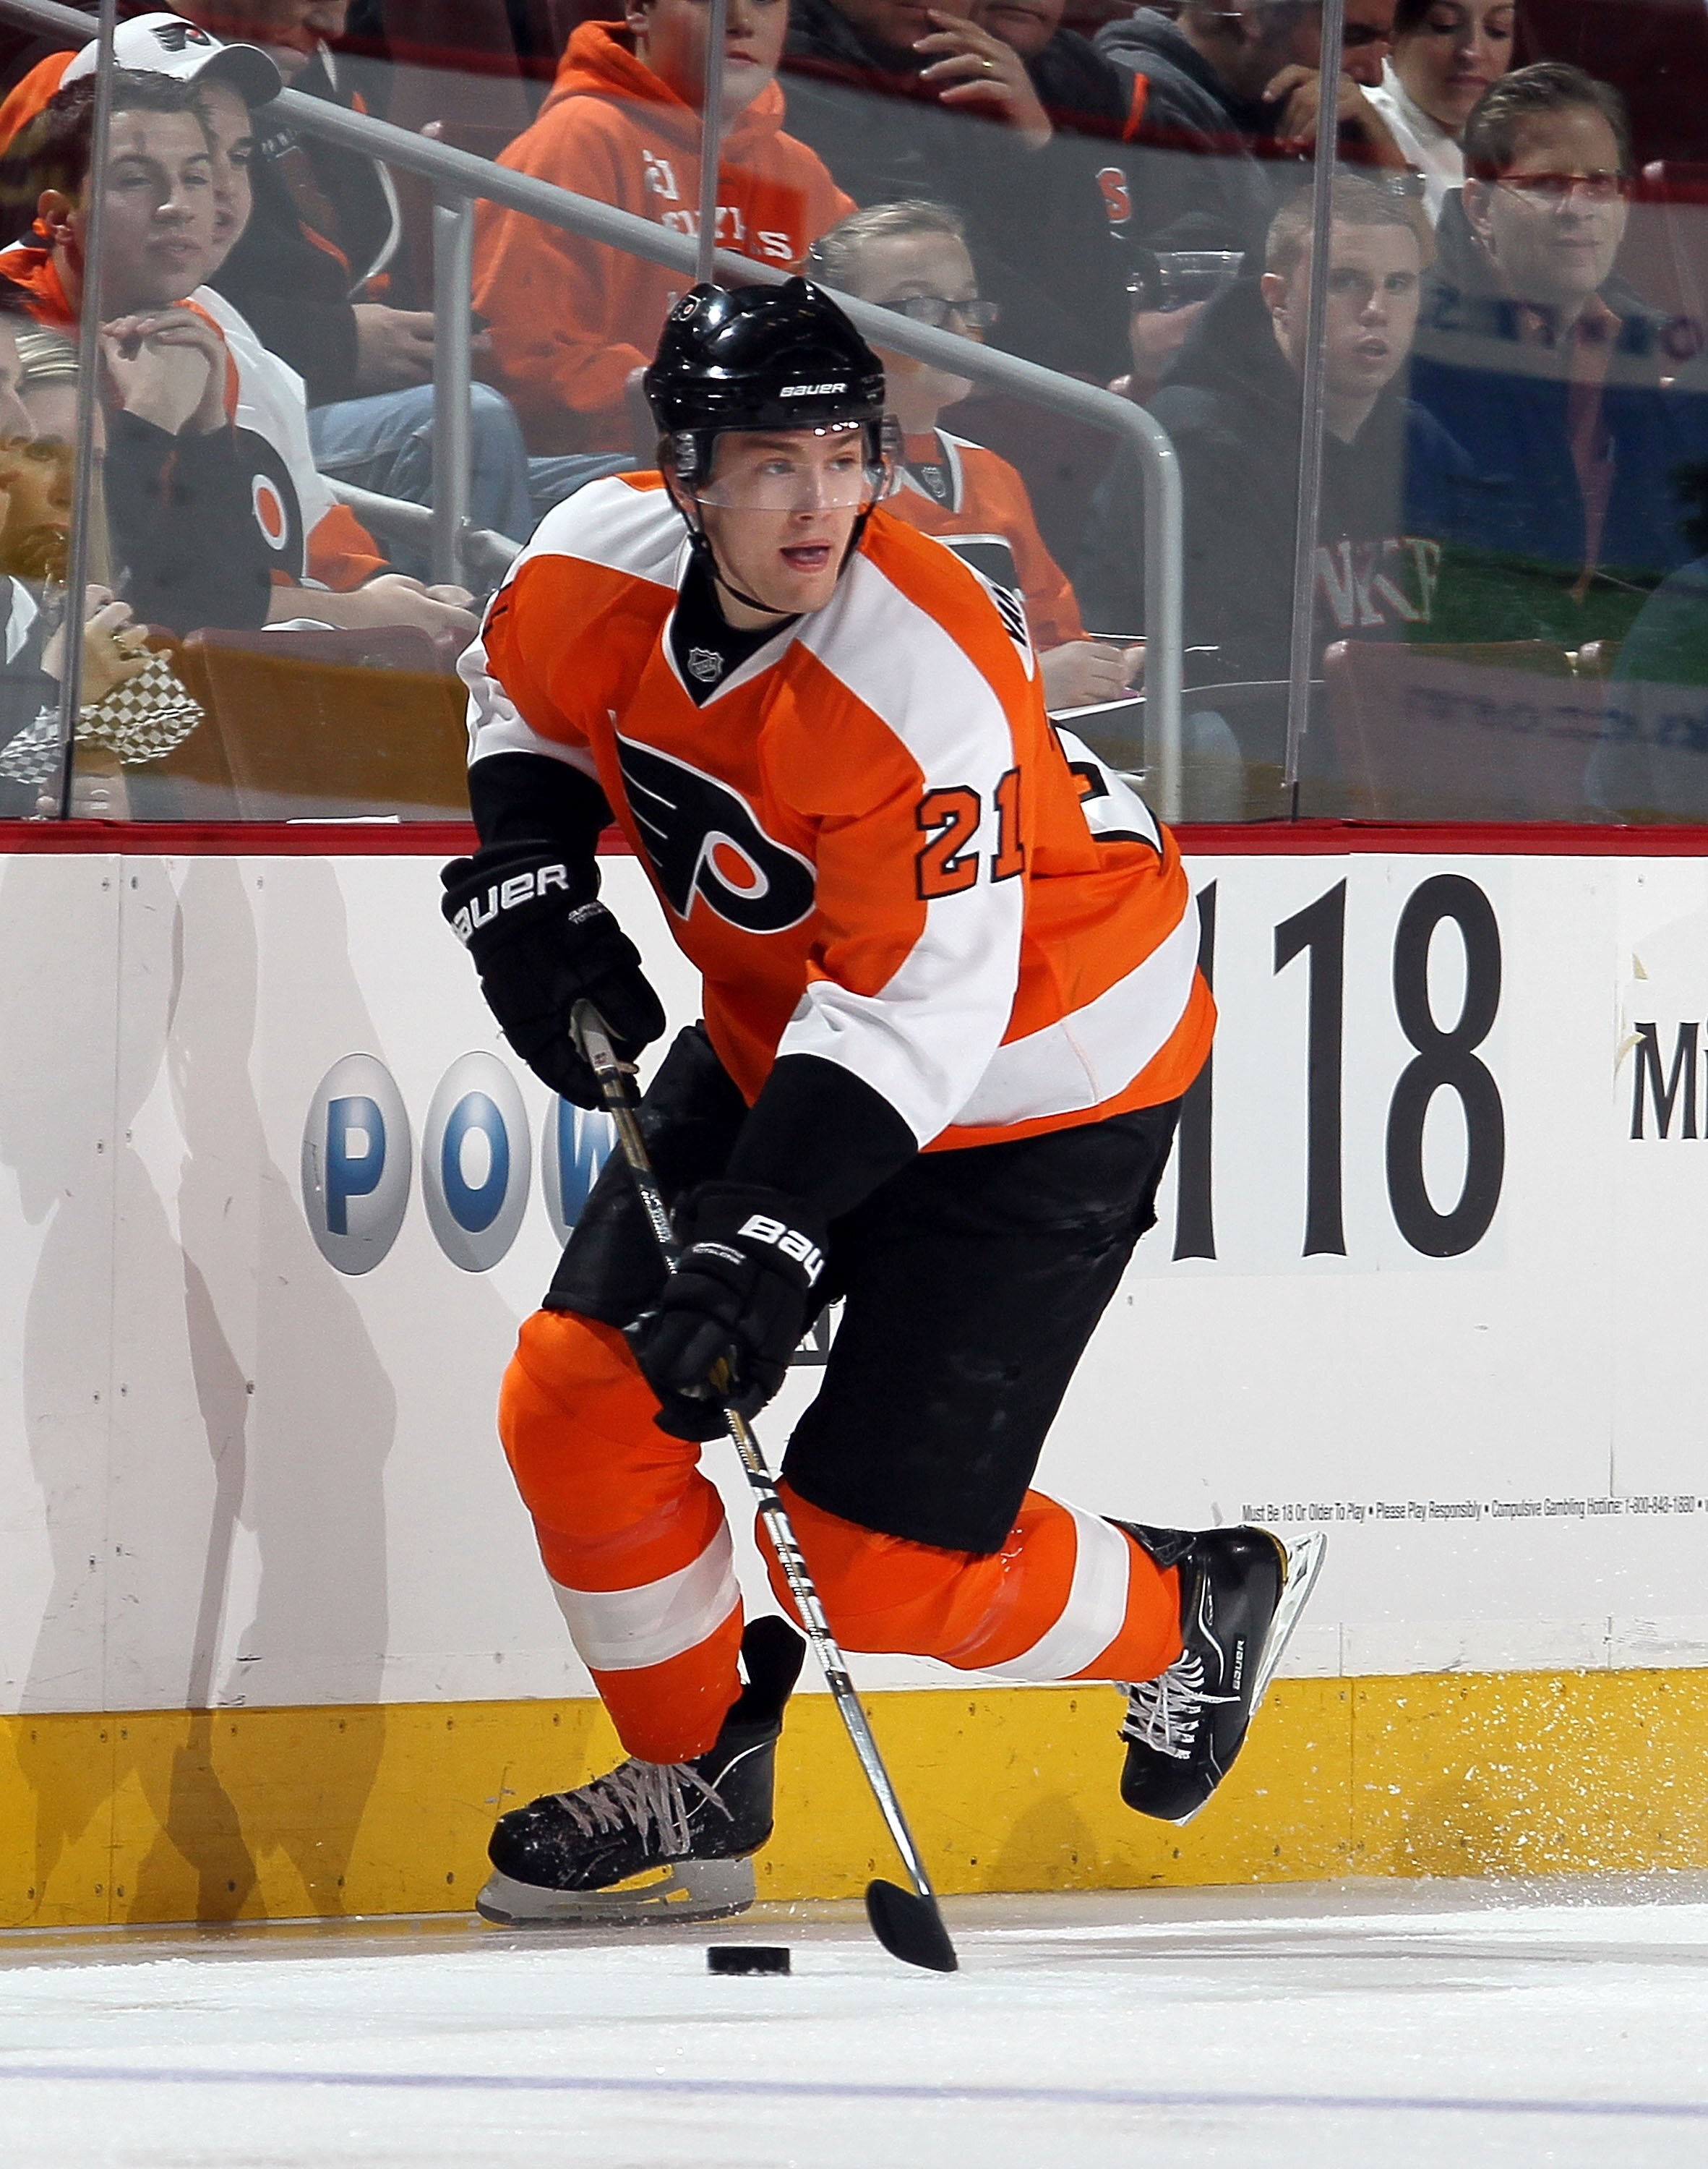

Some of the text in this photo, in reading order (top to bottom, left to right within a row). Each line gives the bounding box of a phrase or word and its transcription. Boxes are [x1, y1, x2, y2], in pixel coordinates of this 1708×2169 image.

[1095, 167, 1132, 223] S
[916, 768, 1025, 900] 21
[451, 864, 570, 943] AUER
[1242, 1504, 1265, 1521] Must
[1267, 1504, 1279, 1521] Be
[1282, 1504, 1293, 1520] 18
[1295, 1503, 1307, 1520] Or
[1308, 1502, 1334, 1520] Older
[1334, 1502, 1346, 1520] To
[1347, 1501, 1365, 1523] Play
[1376, 1502, 1406, 1519] Please
[1408, 1501, 1426, 1522] Play
[1429, 1500, 1481, 1521] Responsibly
[1491, 1500, 1542, 1520] Compulsive
[1544, 1498, 1585, 1519] Gambling
